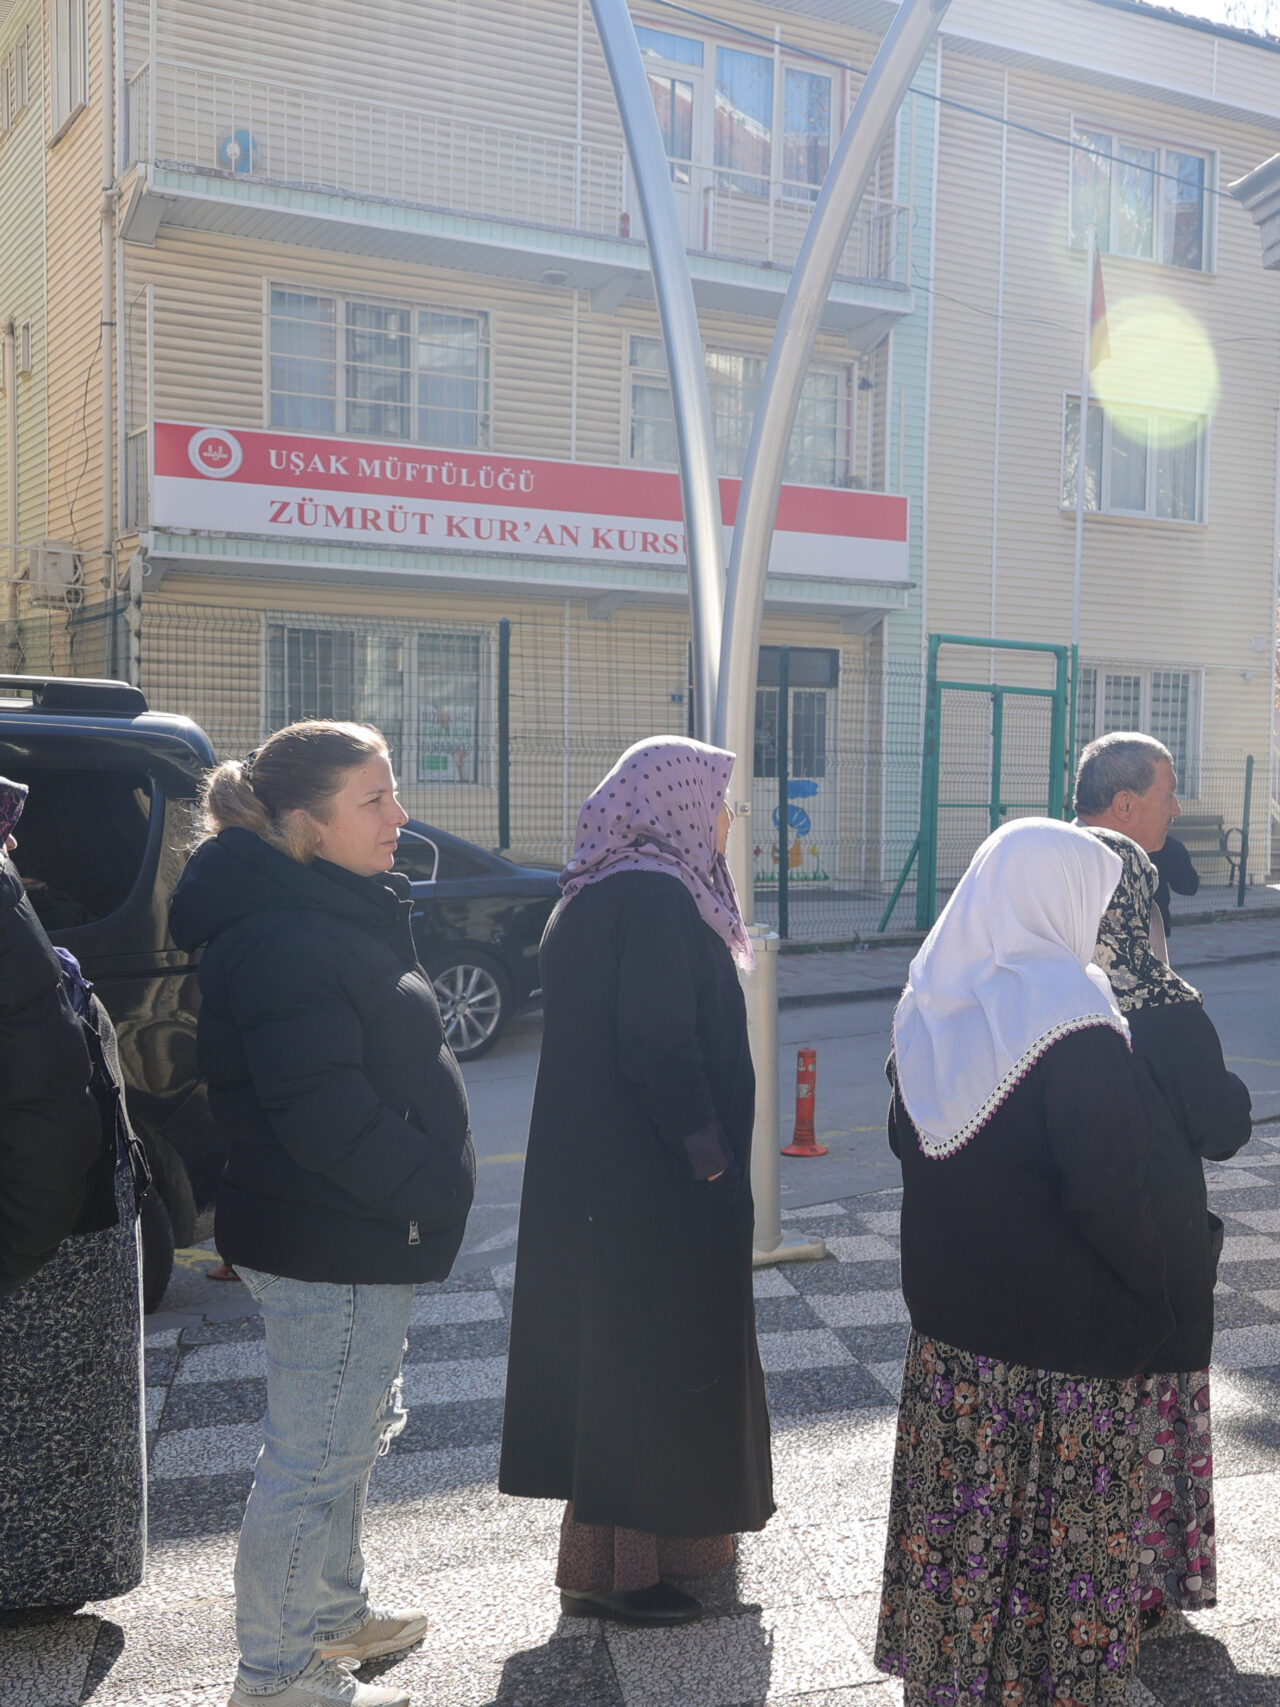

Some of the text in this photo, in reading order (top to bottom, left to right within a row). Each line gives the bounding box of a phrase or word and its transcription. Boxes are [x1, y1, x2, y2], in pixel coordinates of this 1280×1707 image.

[269, 449, 350, 475] UŞAK
[357, 456, 535, 493] MÜFTÜLÜĞÜ
[268, 497, 687, 555] ZÜMRÜT KUR'AN KURS
